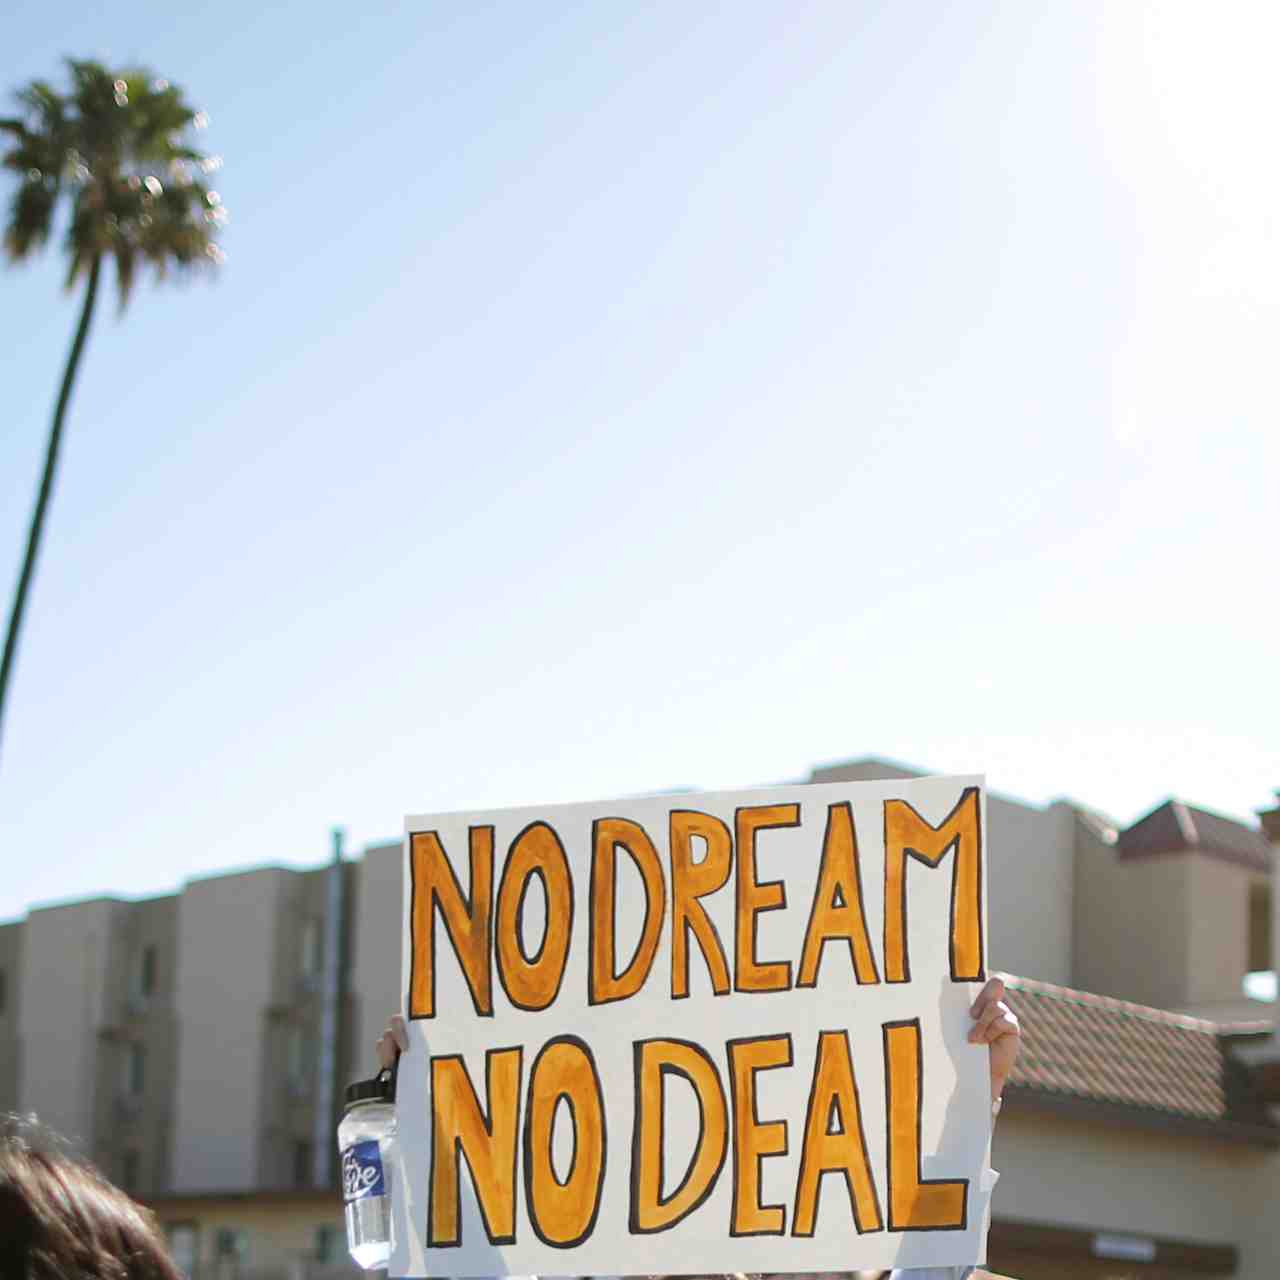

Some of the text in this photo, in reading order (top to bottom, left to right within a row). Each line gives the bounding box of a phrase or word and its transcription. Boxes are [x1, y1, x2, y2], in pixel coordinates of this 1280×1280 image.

[408, 787, 986, 1020] NO DREAM
[426, 1018, 970, 1249] NO DEAL
